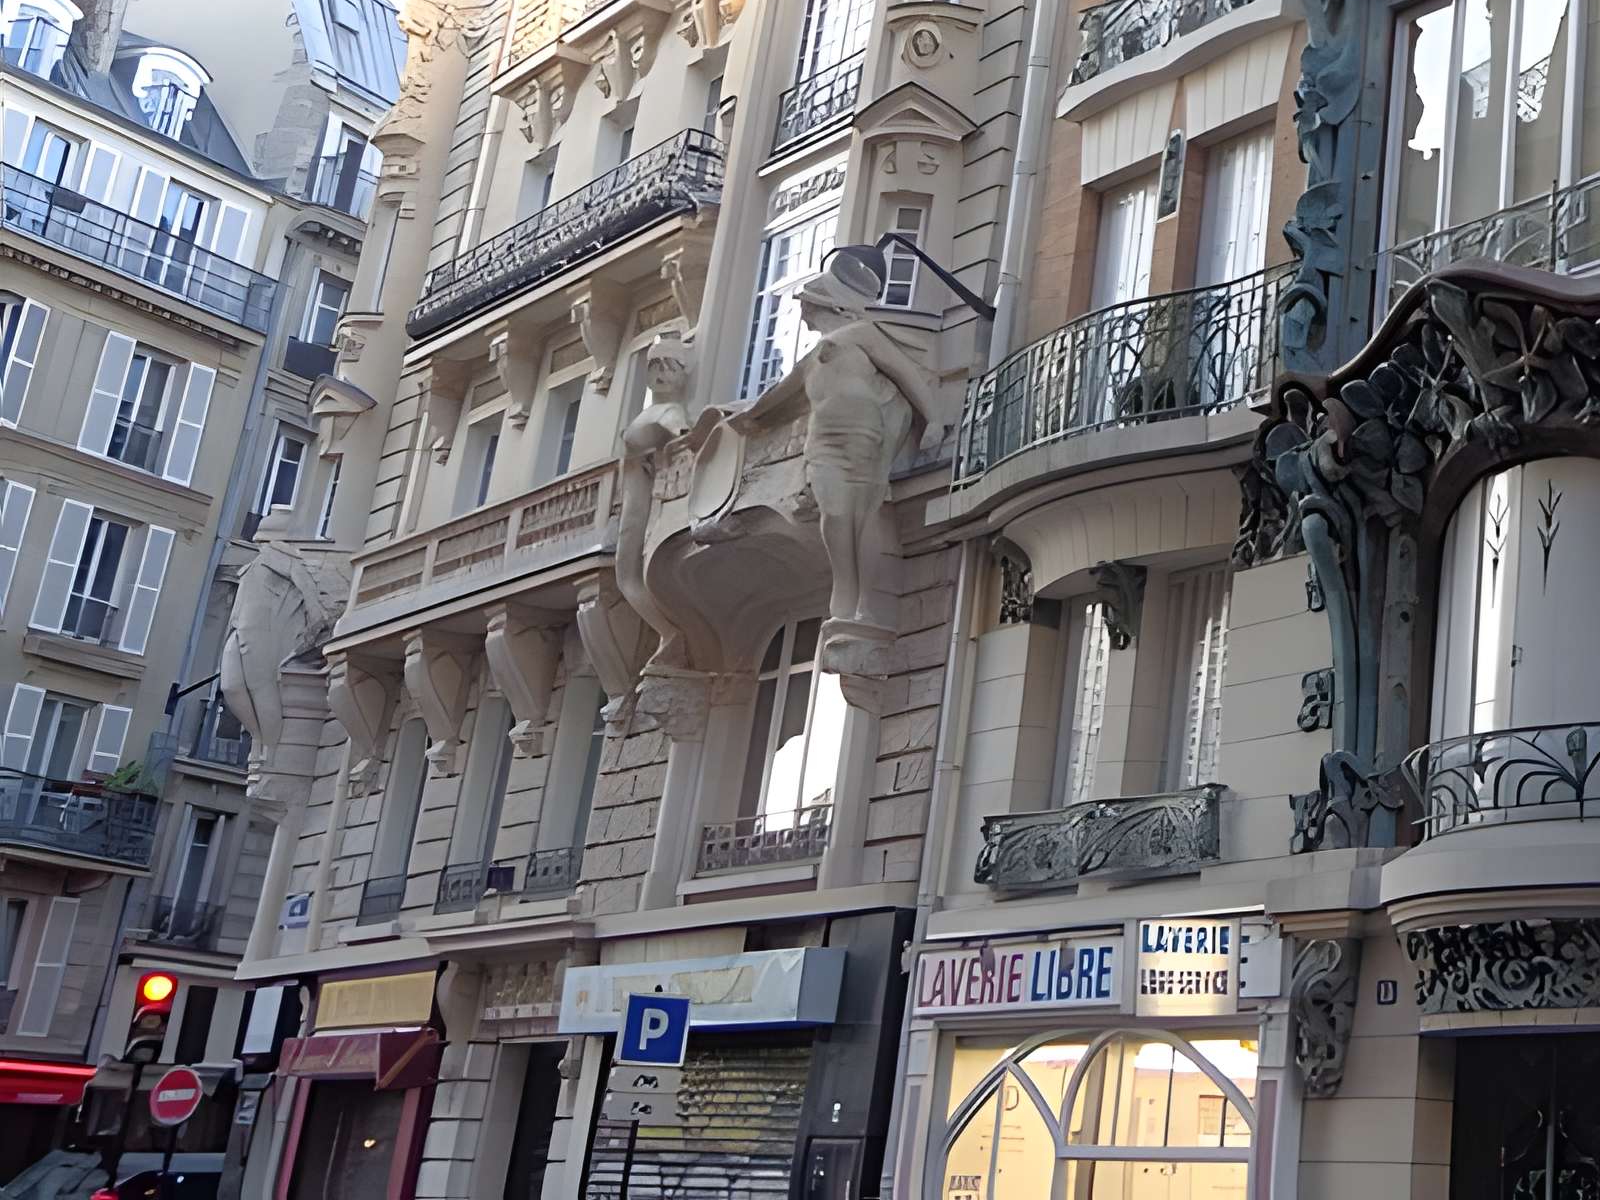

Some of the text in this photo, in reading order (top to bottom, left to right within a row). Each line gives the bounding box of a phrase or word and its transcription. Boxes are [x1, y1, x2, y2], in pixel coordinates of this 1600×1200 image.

[1142, 924, 1230, 954] LAVERIE
[918, 953, 1024, 1008] LAVERIE
[1031, 947, 1113, 1001] LIBRE
[639, 1008, 669, 1050] P
